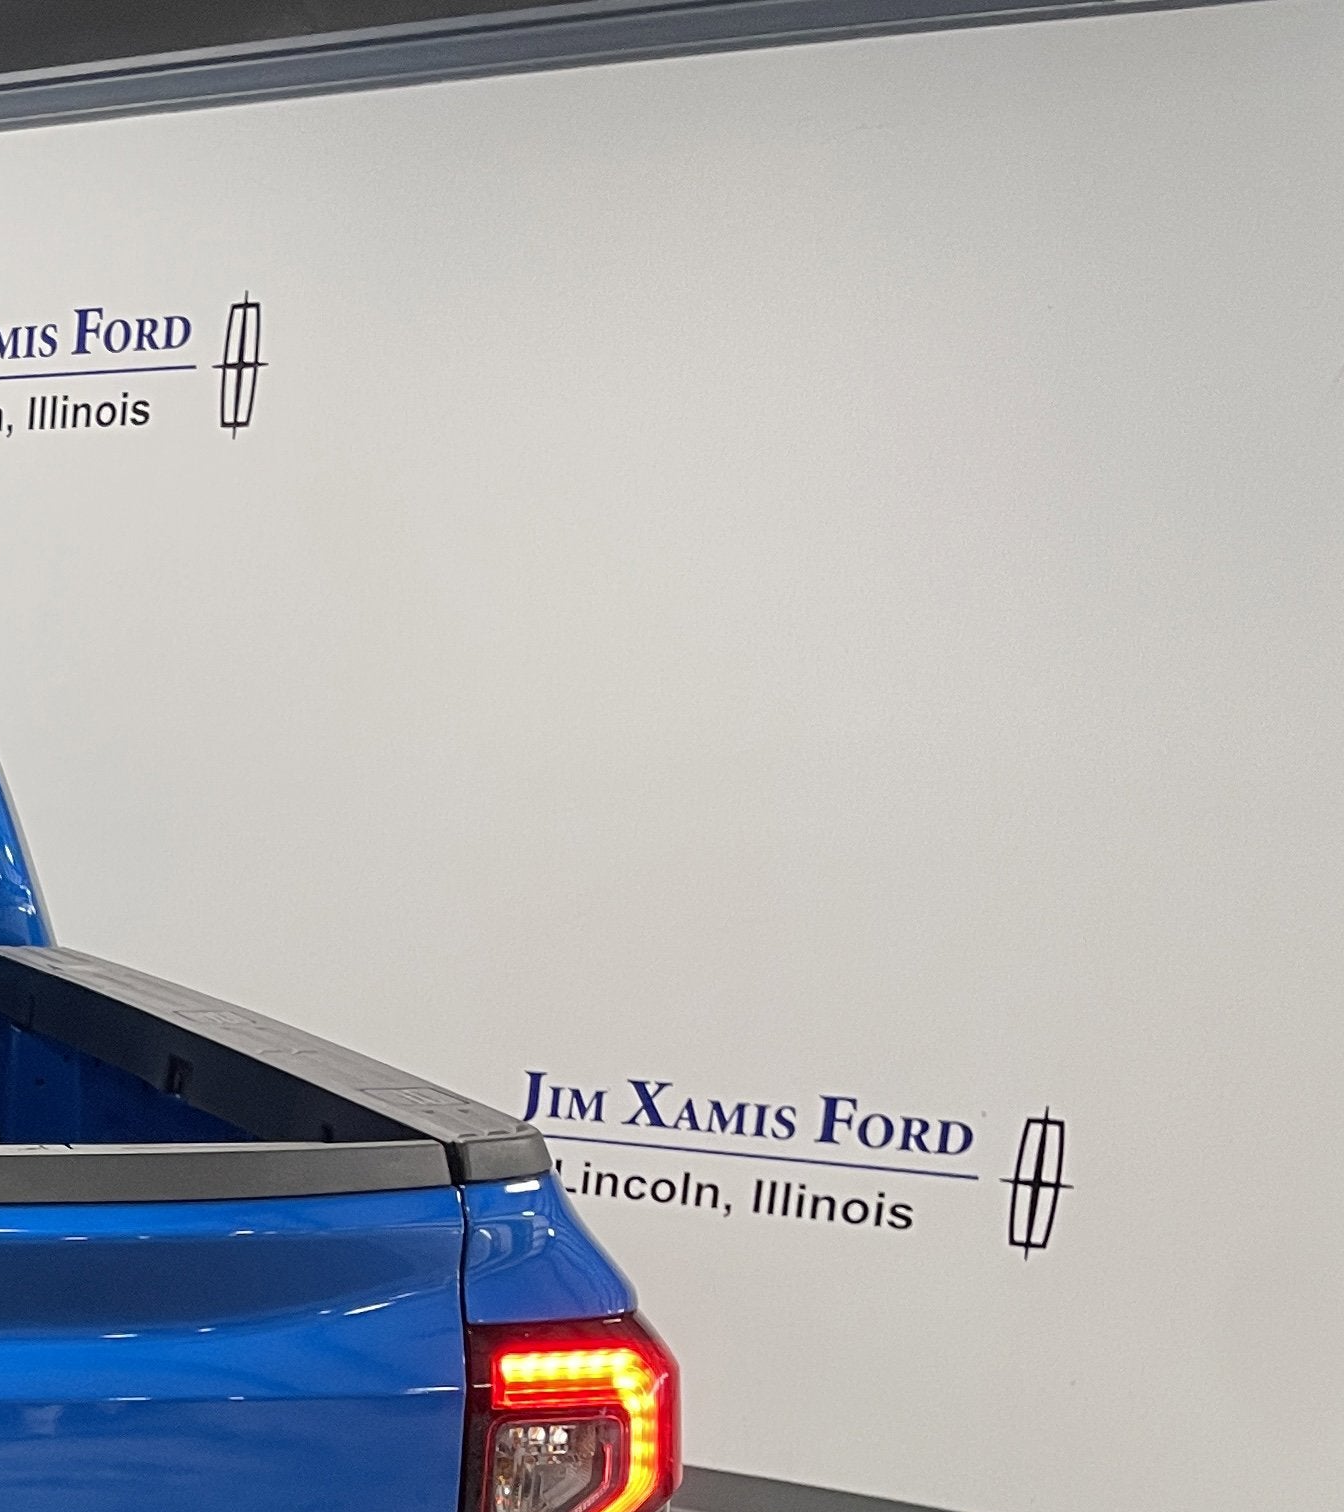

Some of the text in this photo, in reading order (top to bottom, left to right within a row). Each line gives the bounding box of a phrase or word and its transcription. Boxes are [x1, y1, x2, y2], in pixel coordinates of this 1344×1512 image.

[70, 307, 192, 355] FORD
[27, 392, 151, 431] Illinois
[523, 1069, 975, 1156] JIM XAMIS FORD
[752, 1178, 914, 1231] Illinois
